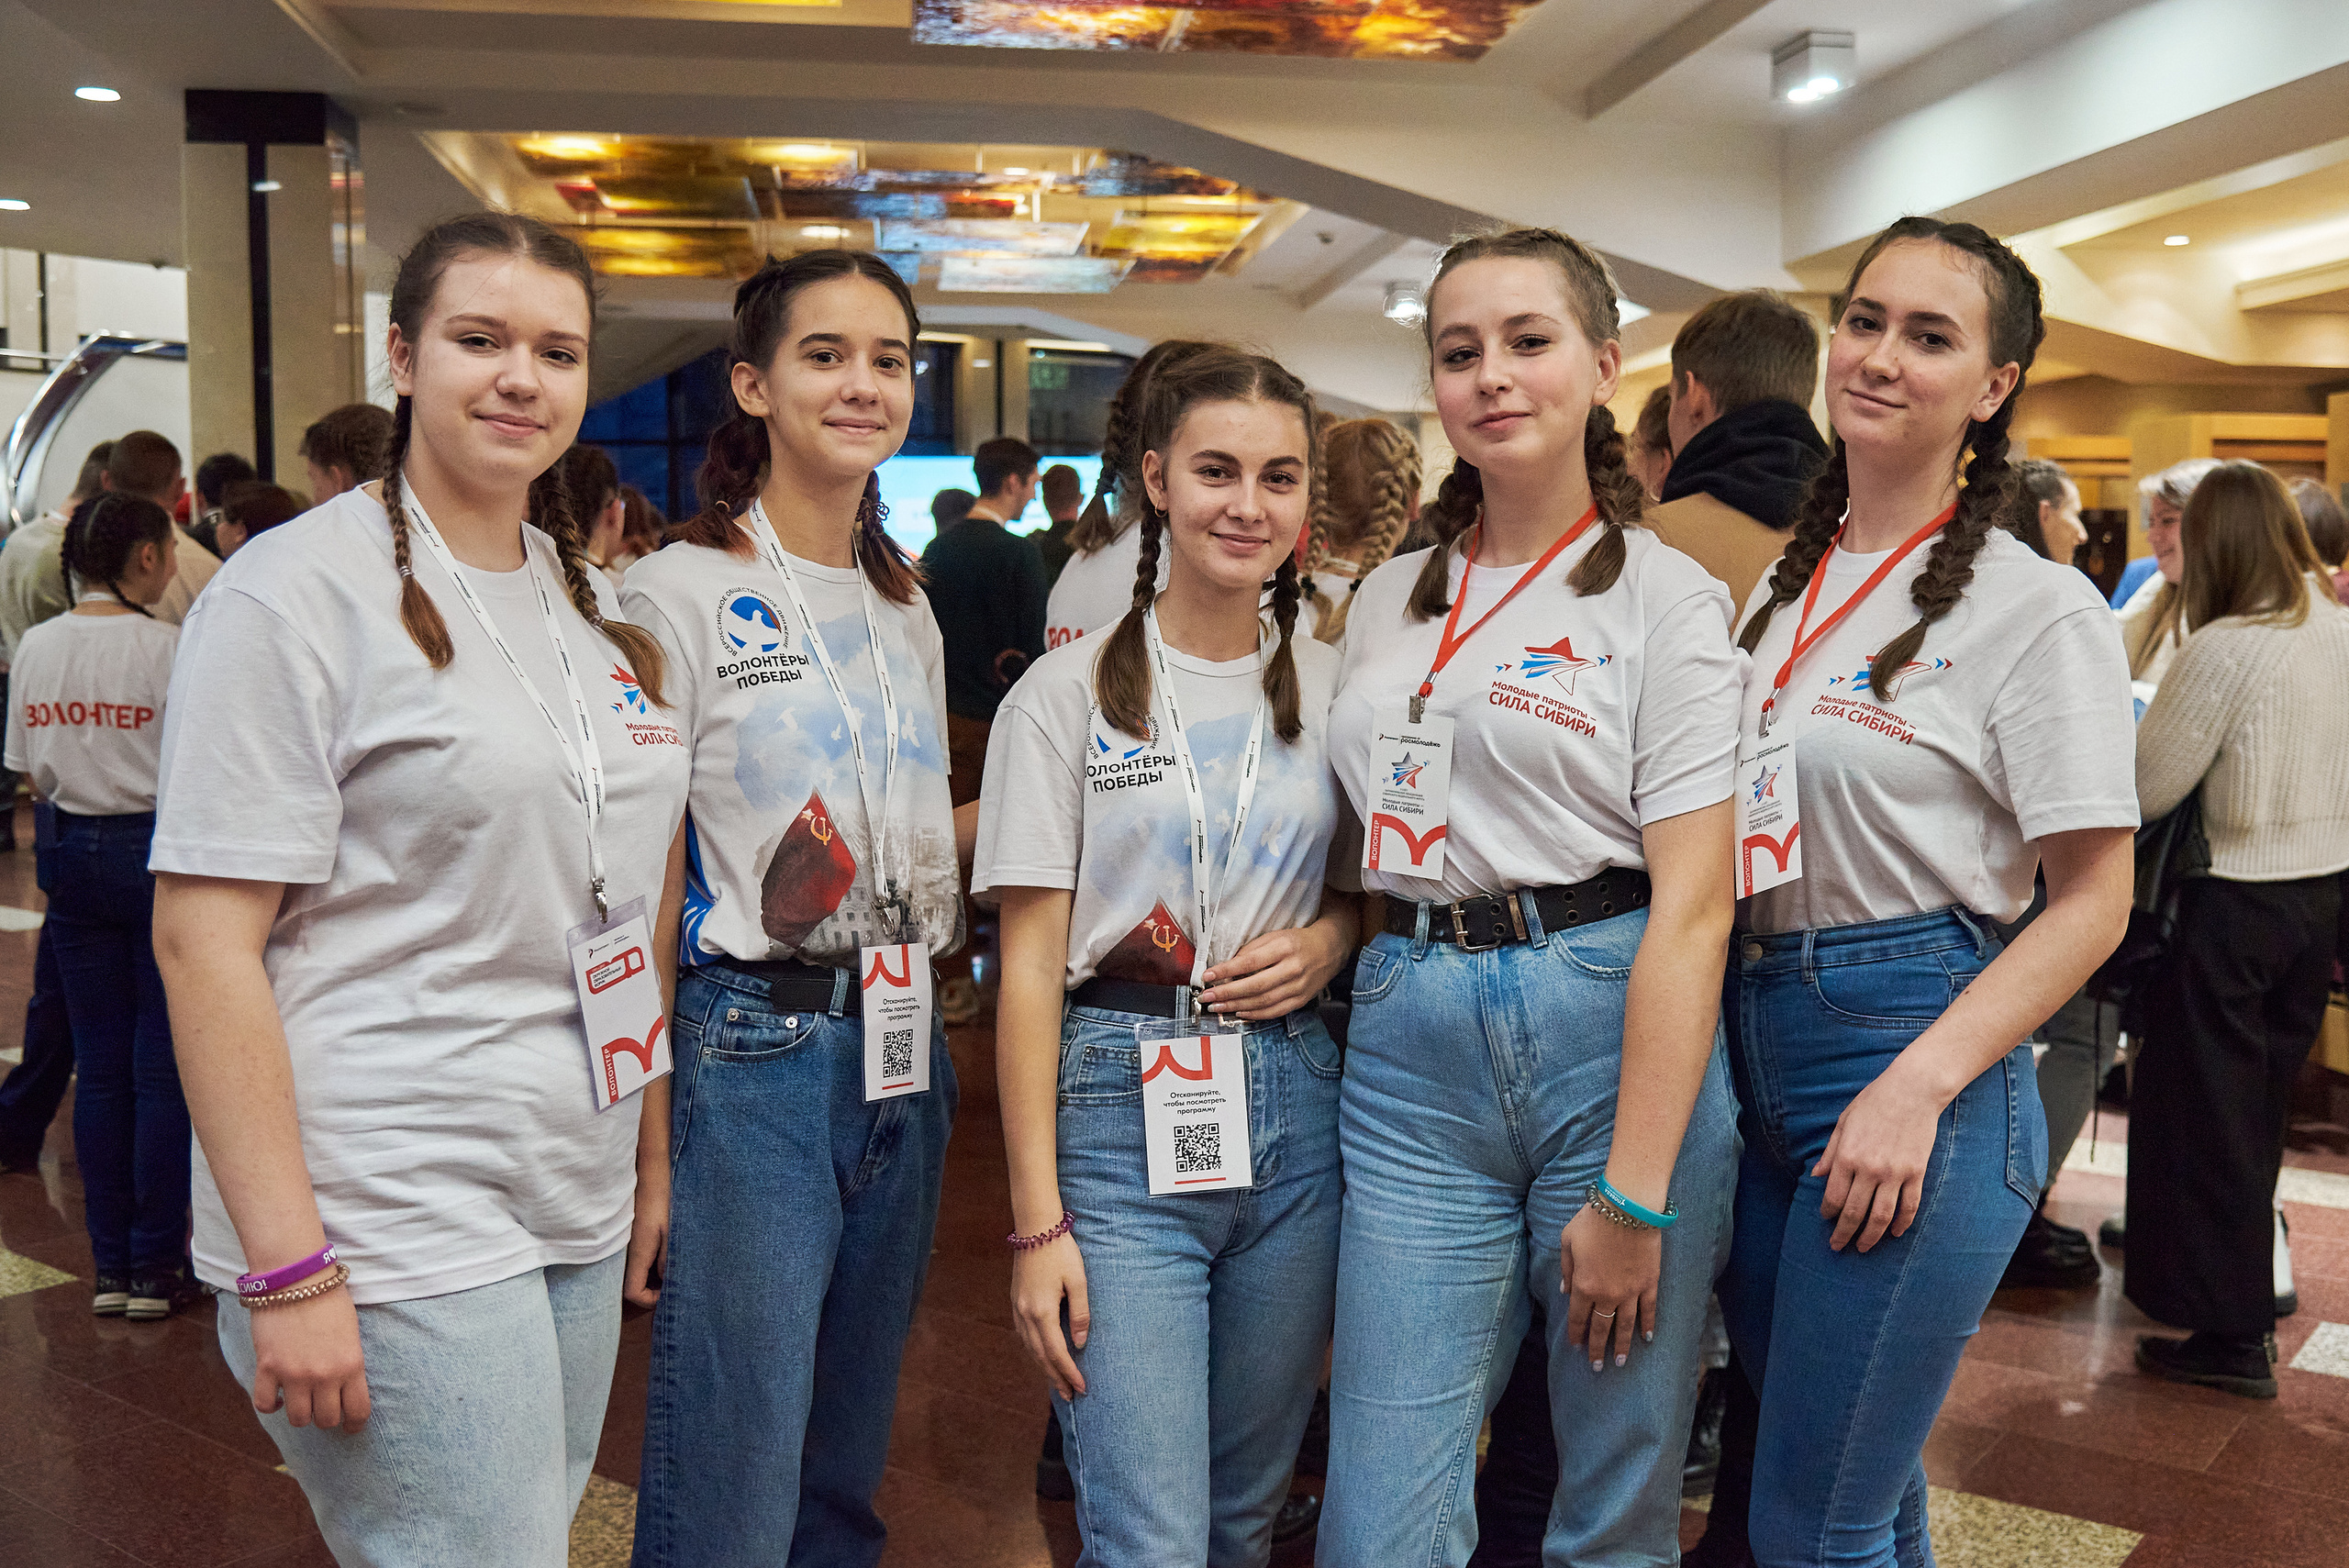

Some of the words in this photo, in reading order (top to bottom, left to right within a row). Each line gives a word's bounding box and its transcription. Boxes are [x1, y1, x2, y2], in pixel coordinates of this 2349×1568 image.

[726, 587, 778, 609] ОБЩЕСТВЕННОЕ
[716, 595, 738, 657] ВСЕРОССИЙСКОЕ
[776, 609, 790, 649] ДВИЖЕНИЕ
[717, 652, 809, 679] ВОЛОНТЁРЫ
[737, 669, 802, 690] ПОБЕДЫ
[1491, 681, 1541, 700] Молодые
[1542, 695, 1588, 719] патриоты
[1818, 695, 1858, 707] Молодые
[1858, 702, 1908, 727] патриоты
[1488, 691, 1531, 715] СИЛА
[1534, 704, 1597, 739] СИБИРИ
[1810, 704, 1845, 718] СИЛА
[1847, 710, 1914, 746] СИБИРИ
[632, 732, 667, 746] СИЛА
[1084, 754, 1176, 778] ОЛОНТЁРЫ
[1093, 771, 1163, 794] ПОБЕДЫ
[1382, 803, 1398, 812] СИЛА
[1398, 806, 1424, 816] СИБИРИ
[1371, 819, 1379, 861] ВОЛОНТЕР
[878, 1006, 893, 1014] чтобы
[604, 1048, 617, 1096] ВОЛОНТЕР
[1163, 1099, 1185, 1107] чтобы
[1186, 1097, 1227, 1106] посмотреть
[1170, 1089, 1221, 1099] Отсканируйте,
[1176, 1106, 1217, 1116] программу
